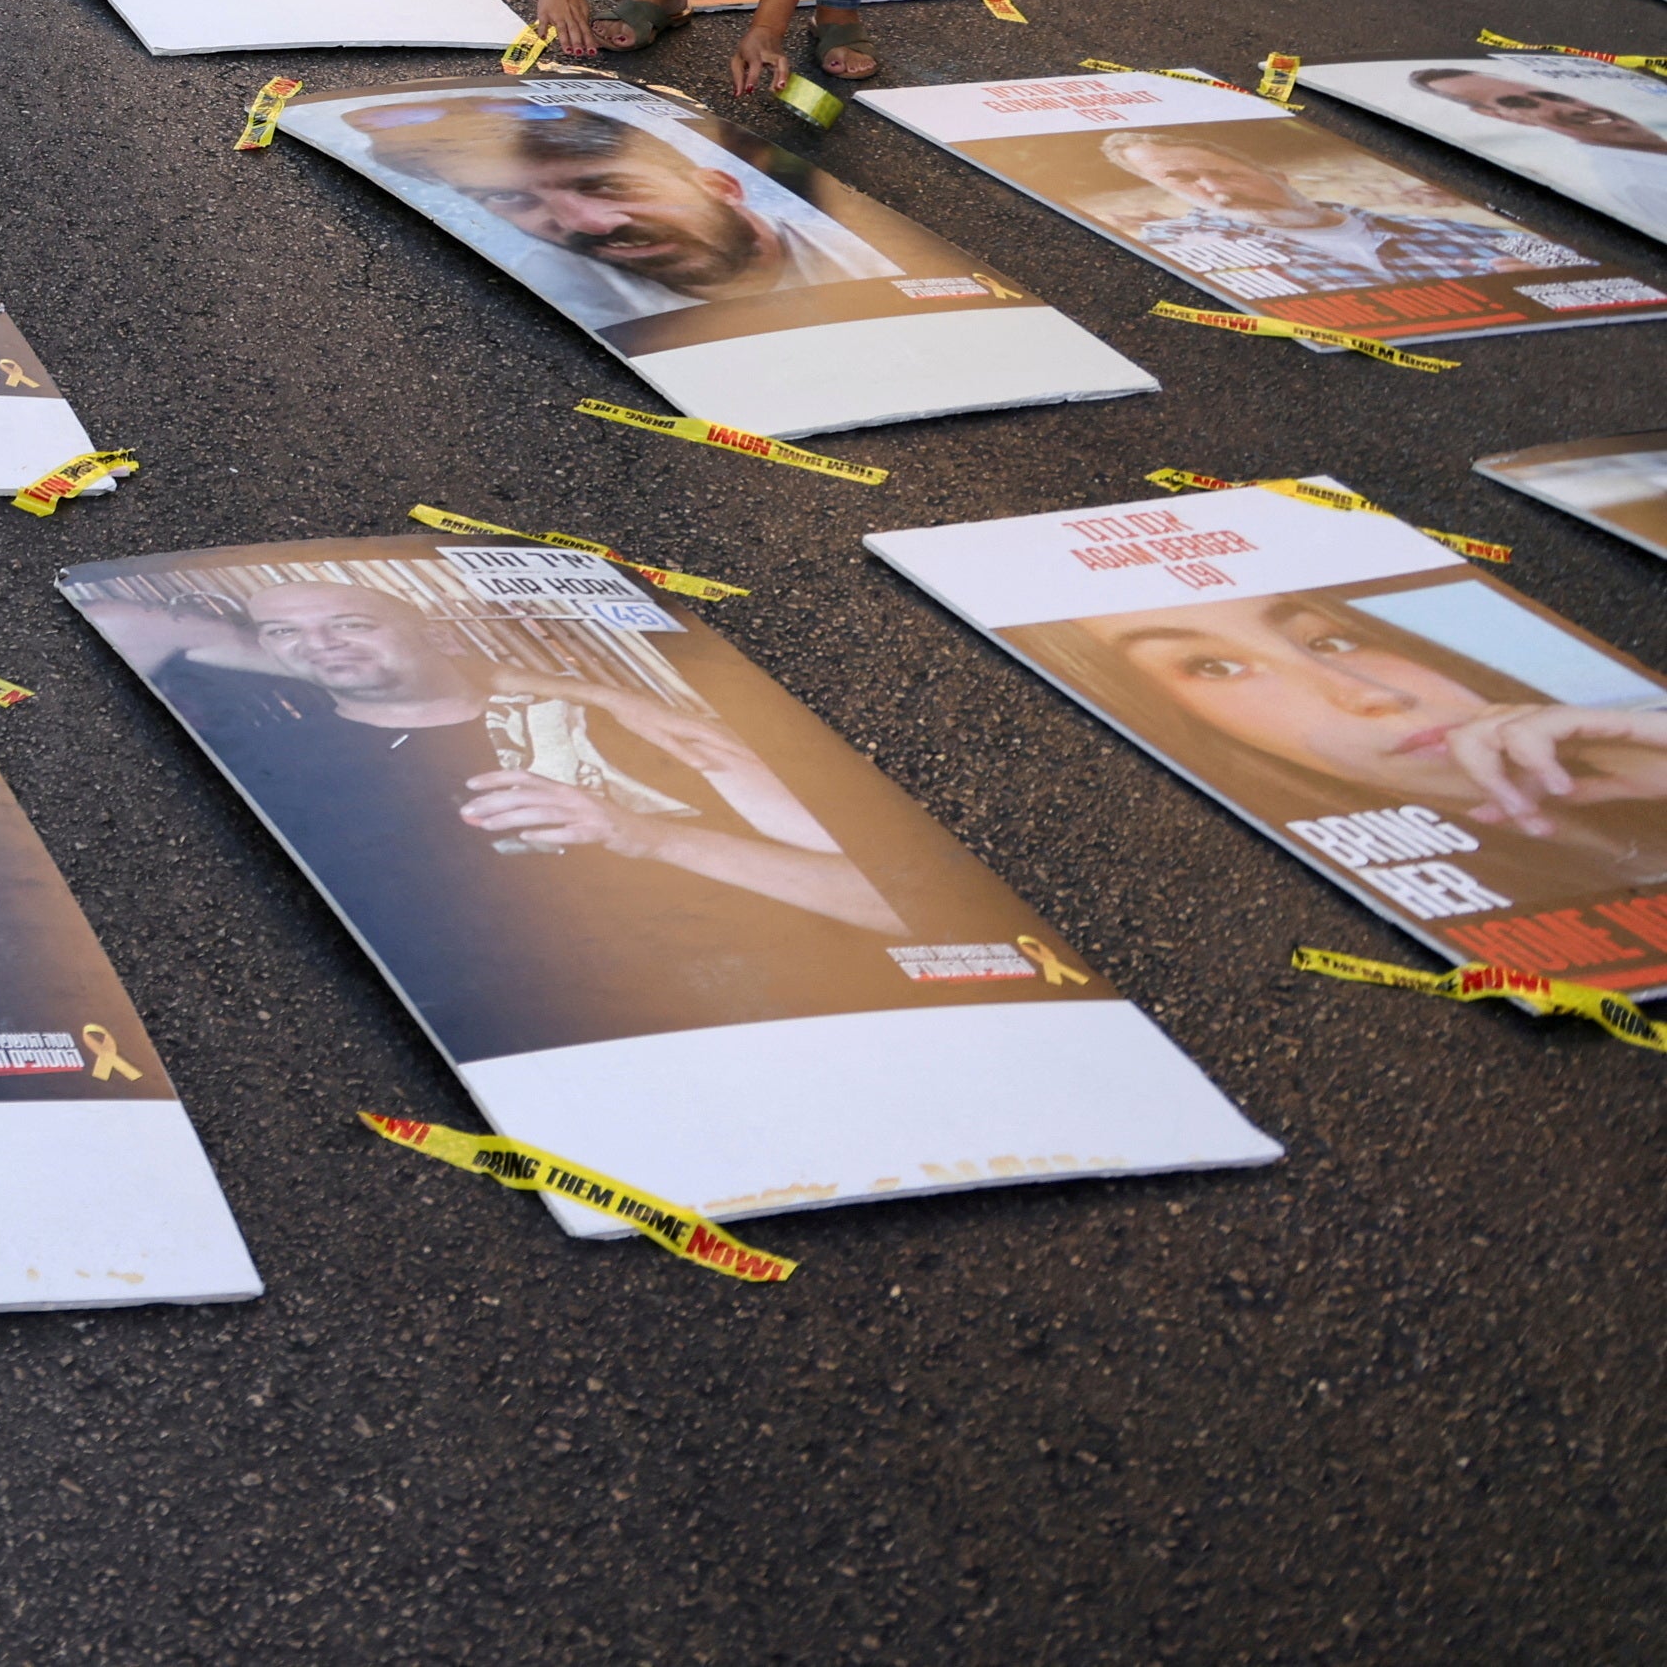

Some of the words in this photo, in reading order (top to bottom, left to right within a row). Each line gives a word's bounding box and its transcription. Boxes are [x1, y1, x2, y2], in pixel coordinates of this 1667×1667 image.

[1157, 238, 1292, 274] BRING
[1203, 267, 1310, 301] HIM
[707, 424, 773, 457] NOW!
[1070, 542, 1164, 572] AGAM
[1155, 529, 1261, 563] BERGER
[478, 577, 544, 596] IAIR
[546, 576, 634, 597] HORN
[1163, 561, 1238, 592] (19)
[593, 603, 675, 630] (45)
[1285, 804, 1481, 869] BRING
[1354, 860, 1515, 921] HER
[1446, 908, 1646, 973] HOME
[472, 1149, 541, 1181] BRING
[545, 1165, 614, 1210] THEM
[616, 1195, 691, 1248] HOME
[684, 1224, 786, 1283] NOW!
